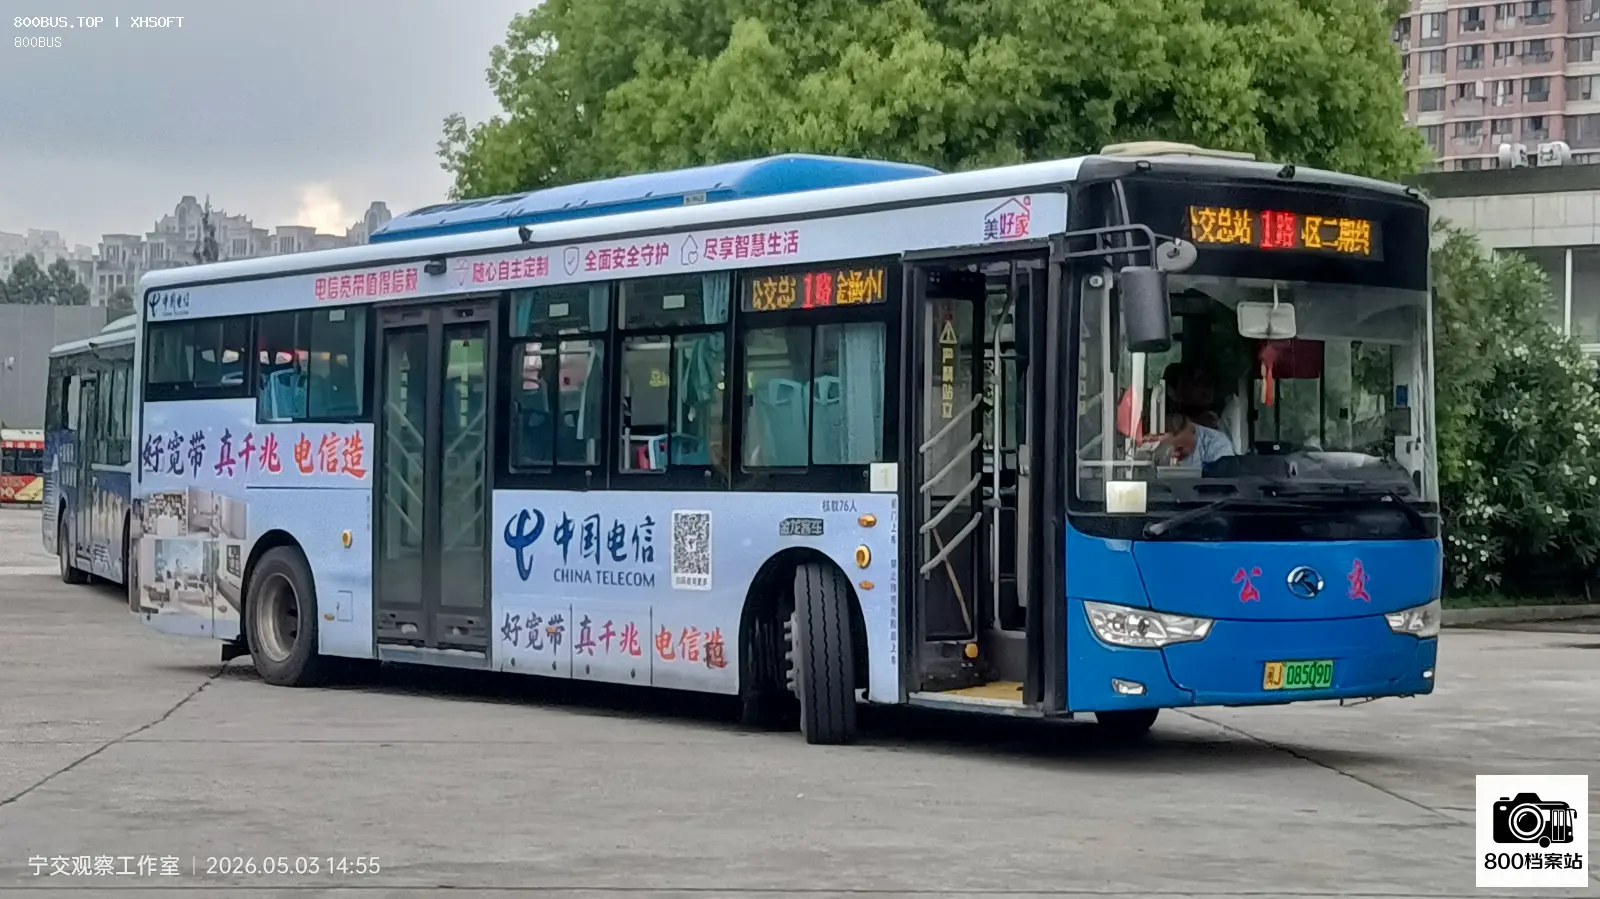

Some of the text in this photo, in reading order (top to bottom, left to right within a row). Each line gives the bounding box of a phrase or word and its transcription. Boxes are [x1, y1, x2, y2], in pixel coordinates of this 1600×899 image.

[984, 212, 1030, 240] 美好家
[1261, 210, 1295, 248] 1路
[315, 230, 799, 300] 电信宽带值得信赖 随心自主定制 全面安全守护 尽享智慧生活
[752, 276, 796, 310] 公交总
[803, 272, 832, 310] 1路
[142, 428, 367, 479] 好宽带 真千兆 电信造
[553, 510, 656, 566] 中国电信
[553, 568, 592, 585] CHINA
[596, 570, 656, 588] TELECOM
[501, 612, 728, 669] 好宽带 真千兆 电信造
